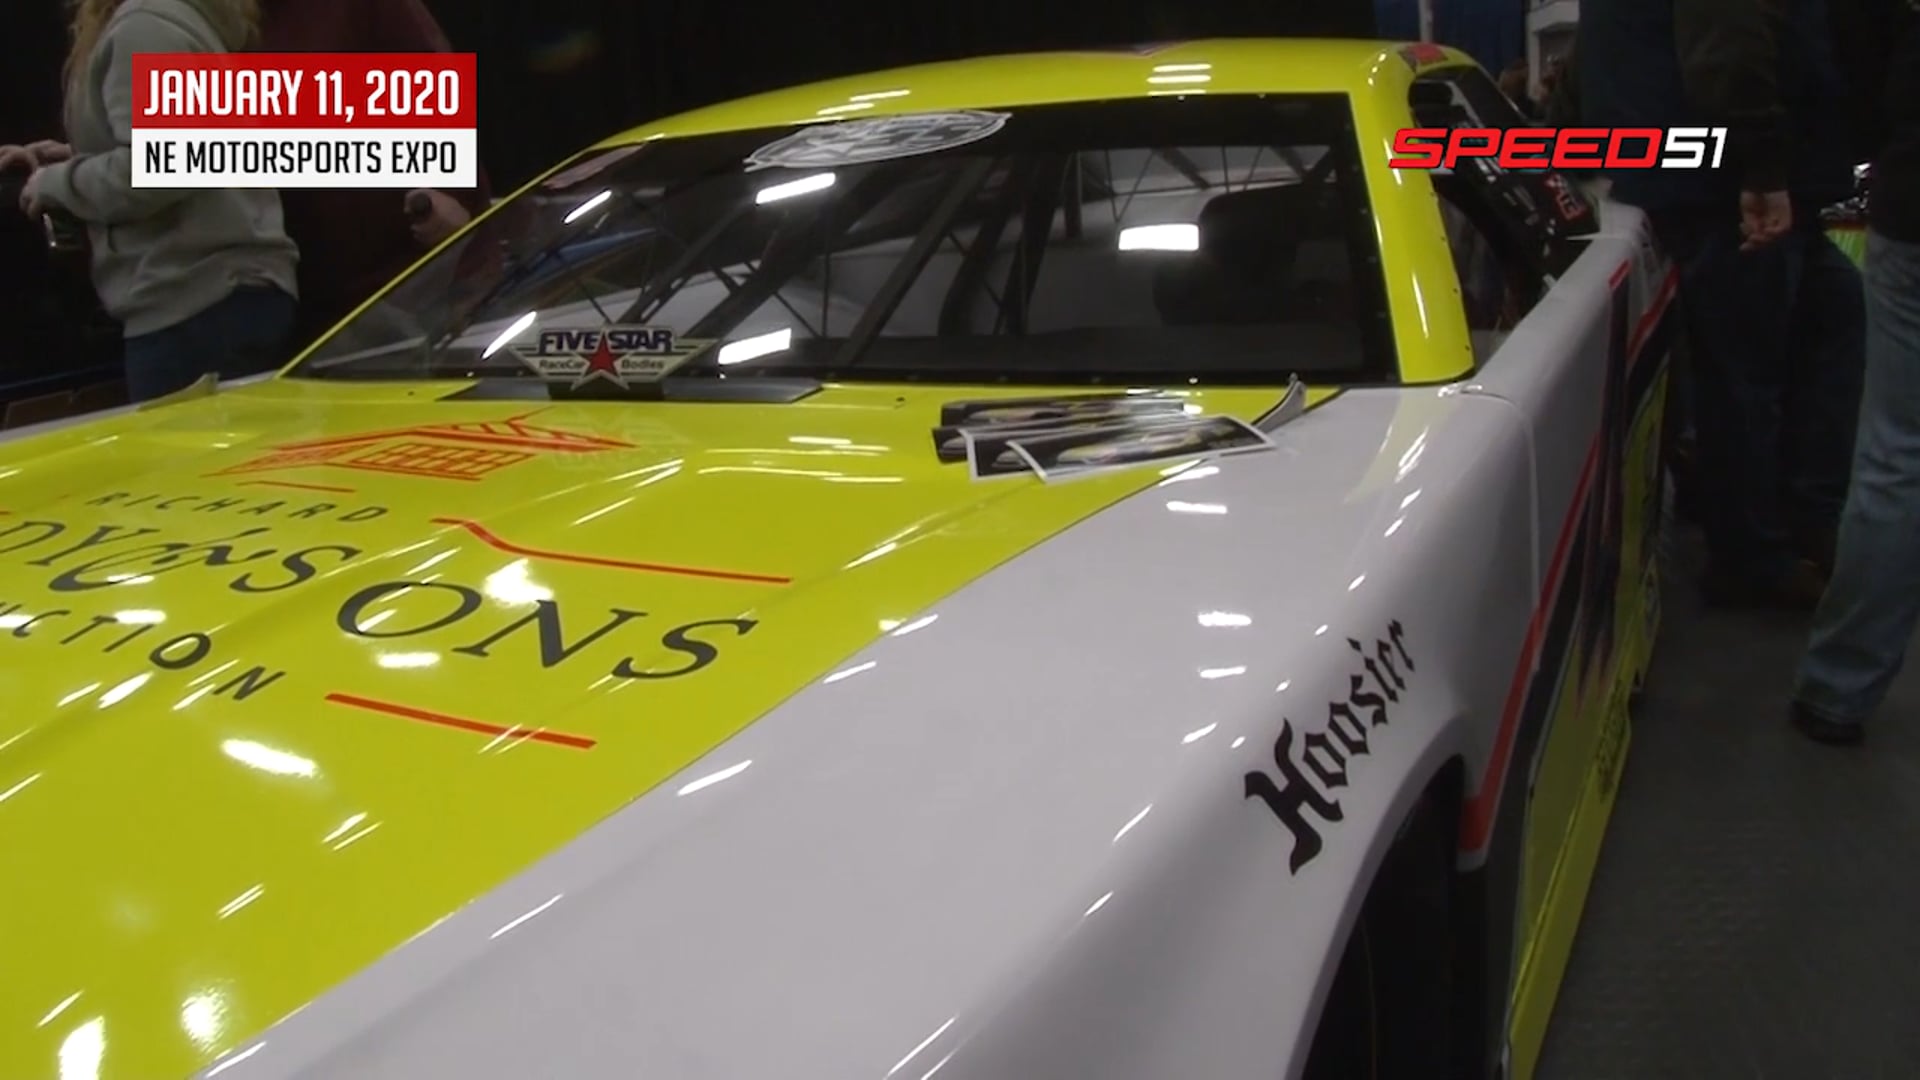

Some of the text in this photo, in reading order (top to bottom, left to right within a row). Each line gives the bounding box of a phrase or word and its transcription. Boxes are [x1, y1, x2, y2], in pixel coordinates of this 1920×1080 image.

[539, 330, 673, 355] FIVE STAR
[621, 358, 665, 370] Bodies
[85, 491, 389, 523] RICHARD
[1244, 618, 1416, 877] Hoosier
